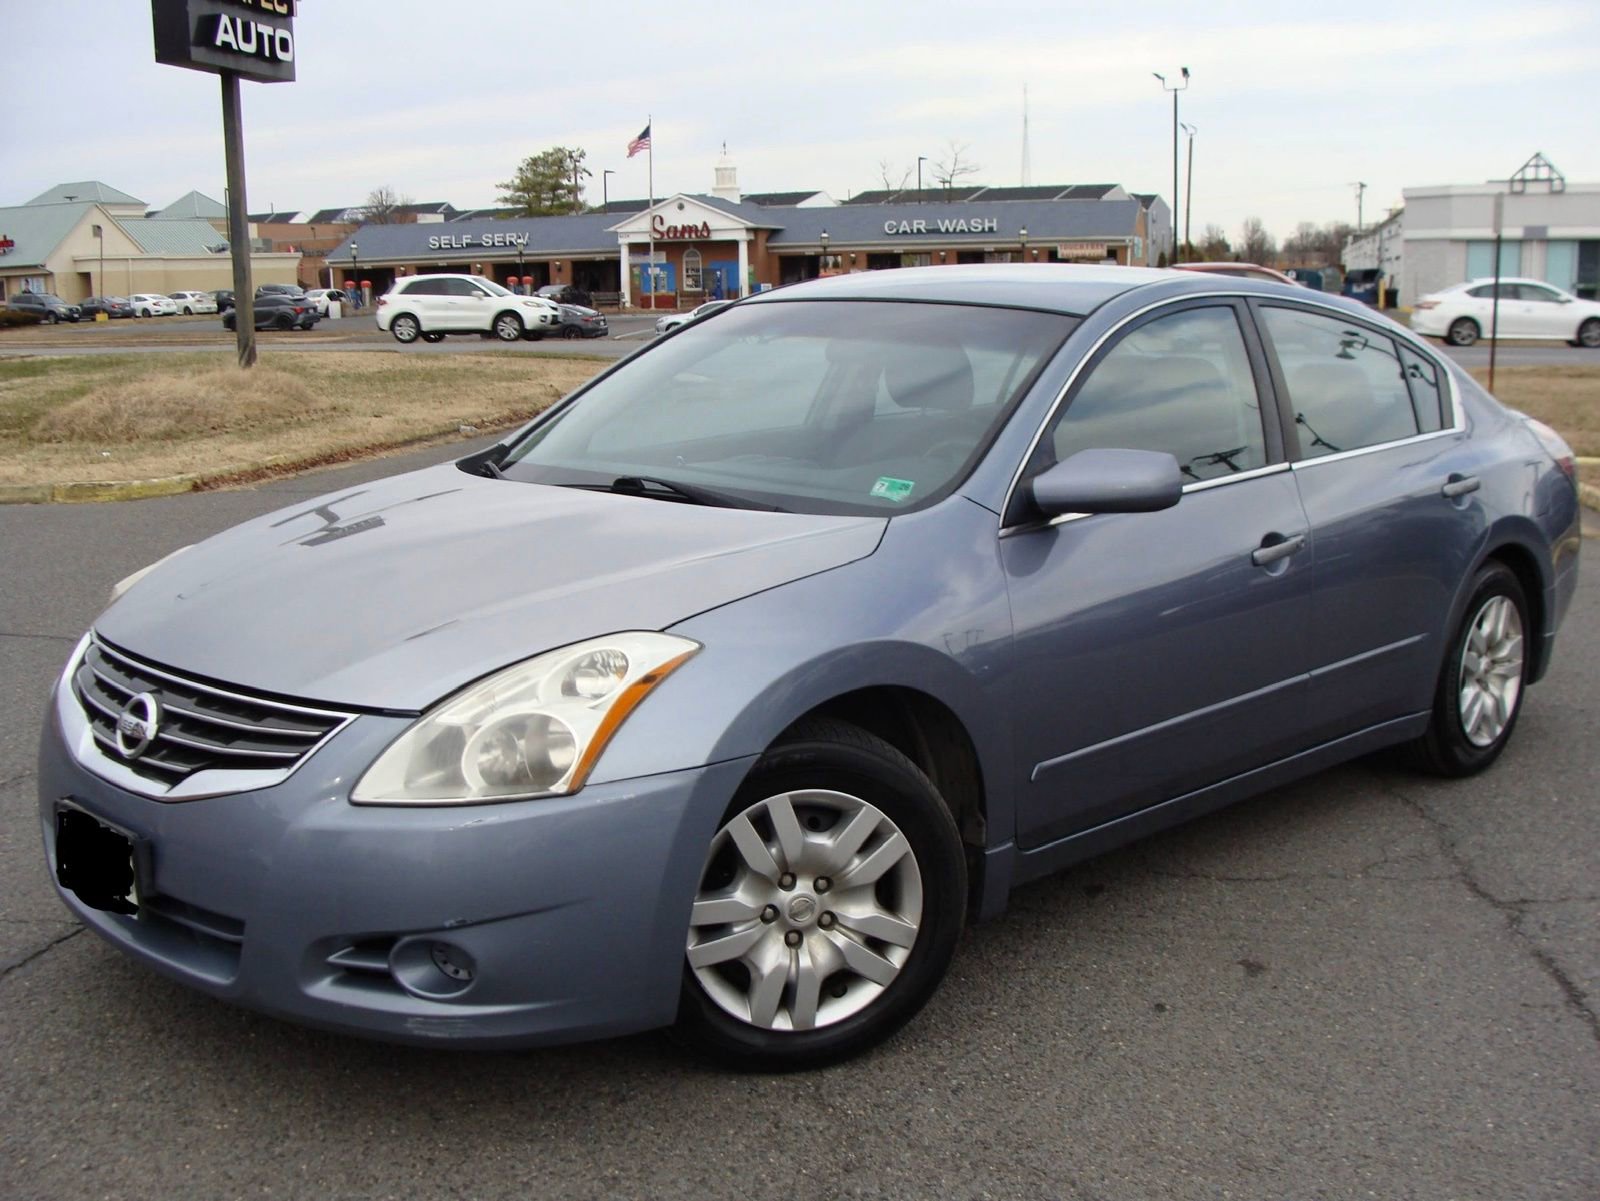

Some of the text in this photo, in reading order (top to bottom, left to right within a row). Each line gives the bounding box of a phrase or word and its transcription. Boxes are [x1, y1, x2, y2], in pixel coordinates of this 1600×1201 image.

[215, 13, 294, 62] AUTO
[652, 214, 711, 240] Sams
[884, 218, 998, 234] CAR WASH
[428, 232, 530, 249] SELF SERV
